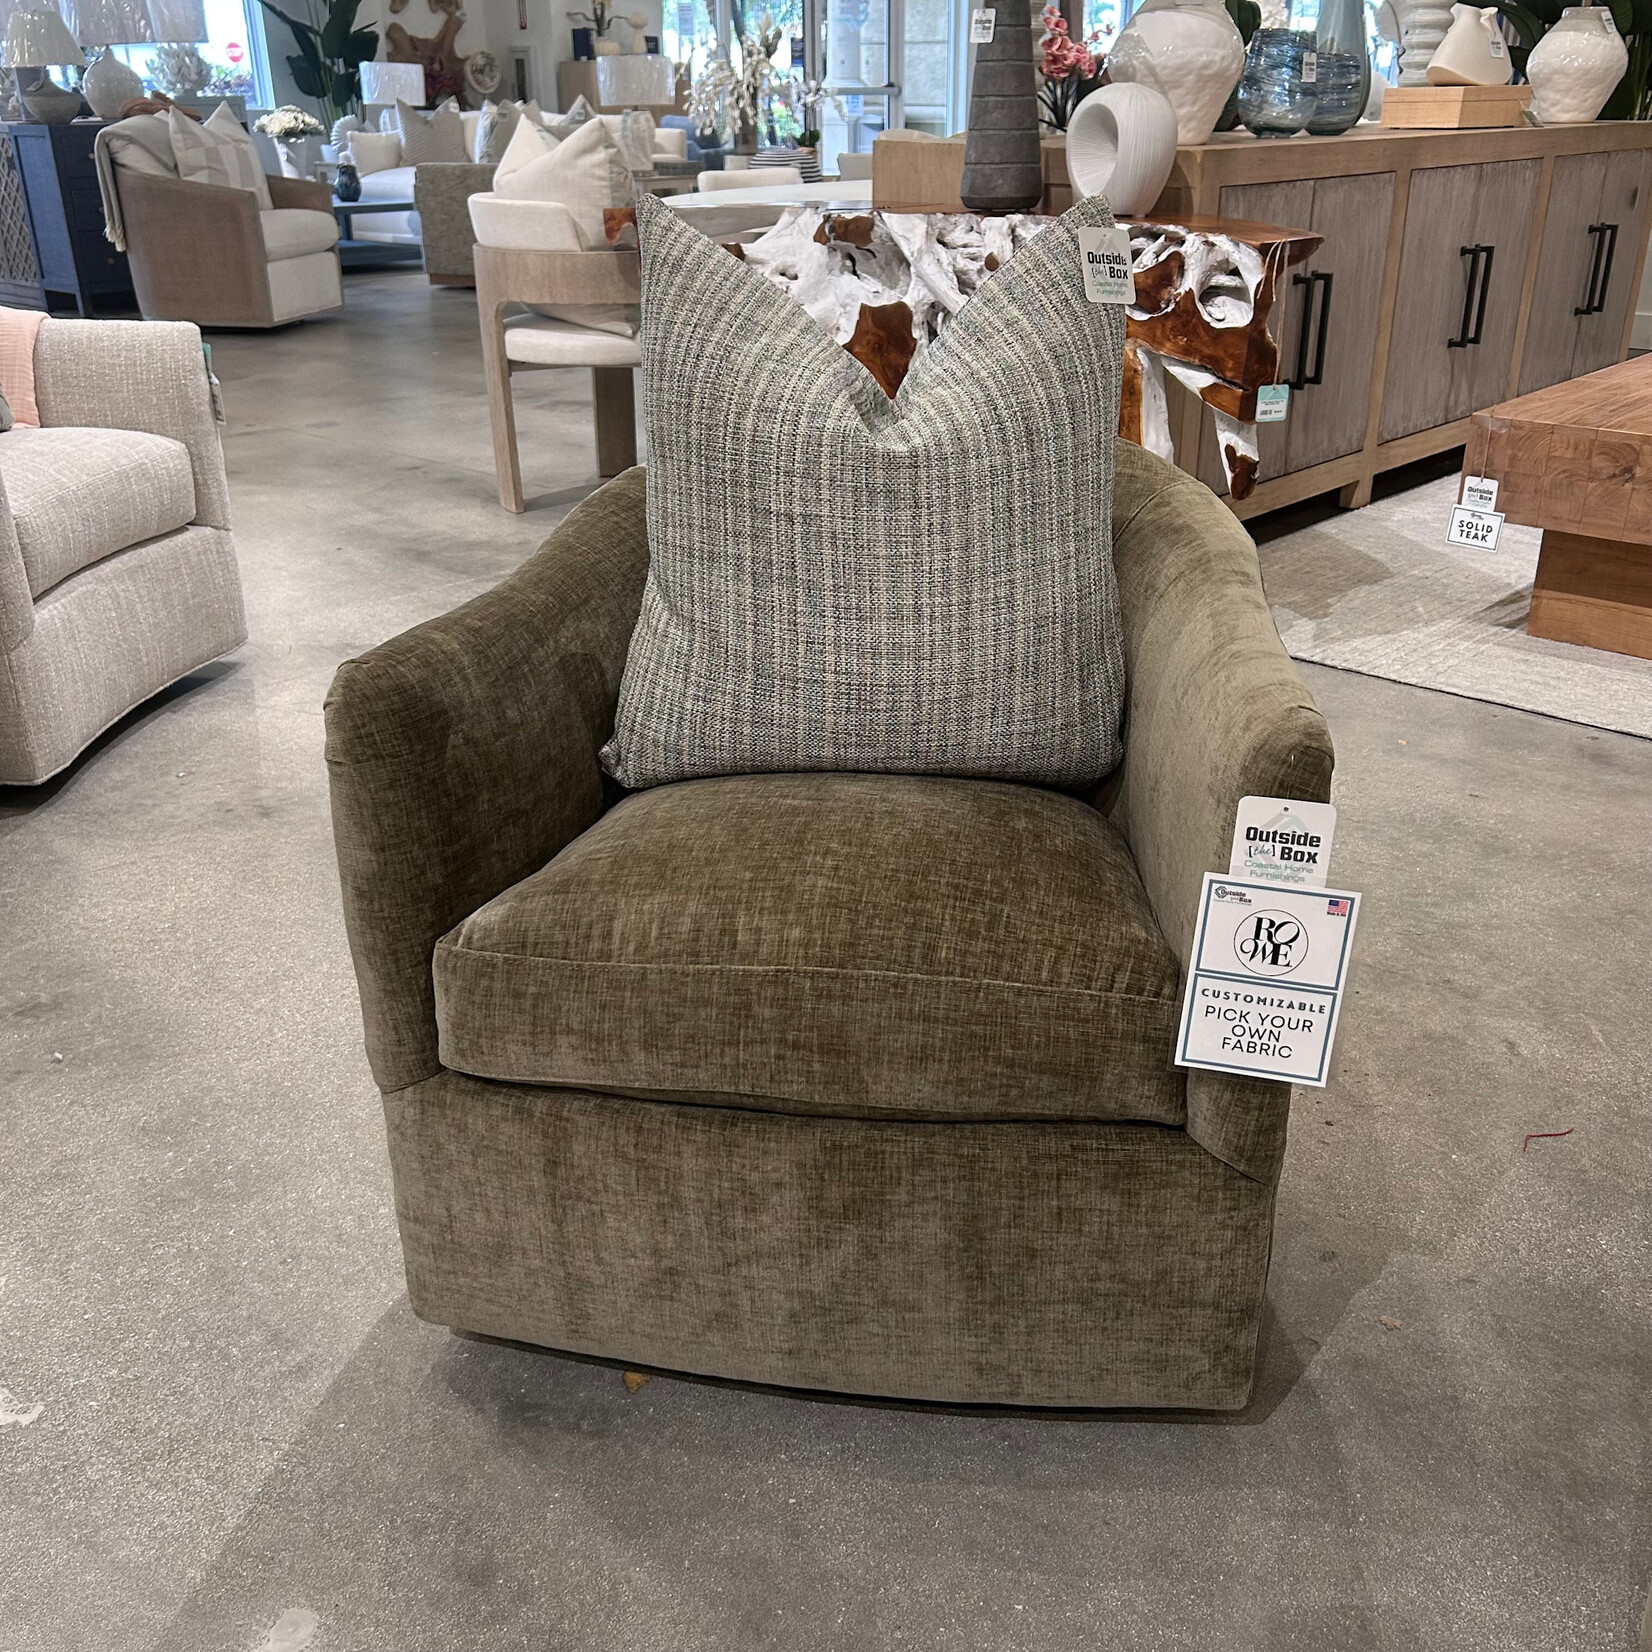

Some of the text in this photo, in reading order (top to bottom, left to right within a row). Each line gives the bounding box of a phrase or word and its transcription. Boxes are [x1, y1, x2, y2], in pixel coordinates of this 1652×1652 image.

[1087, 252, 1127, 265] Outside
[1109, 266, 1128, 279] Box
[1467, 486, 1493, 495] Outside
[1458, 520, 1493, 533] SOLID
[1459, 529, 1488, 542] TEAK
[1245, 826, 1321, 848] Outside
[1280, 846, 1319, 864] Box
[1244, 860, 1313, 874] Coastal Home
[1250, 870, 1305, 882] Furnishings
[1201, 988, 1326, 1014] CUSTOMIZABLE
[1205, 1005, 1313, 1033] PICK YOUR
[1231, 1024, 1281, 1043] OWN
[1221, 1037, 1293, 1058] FABRIC
